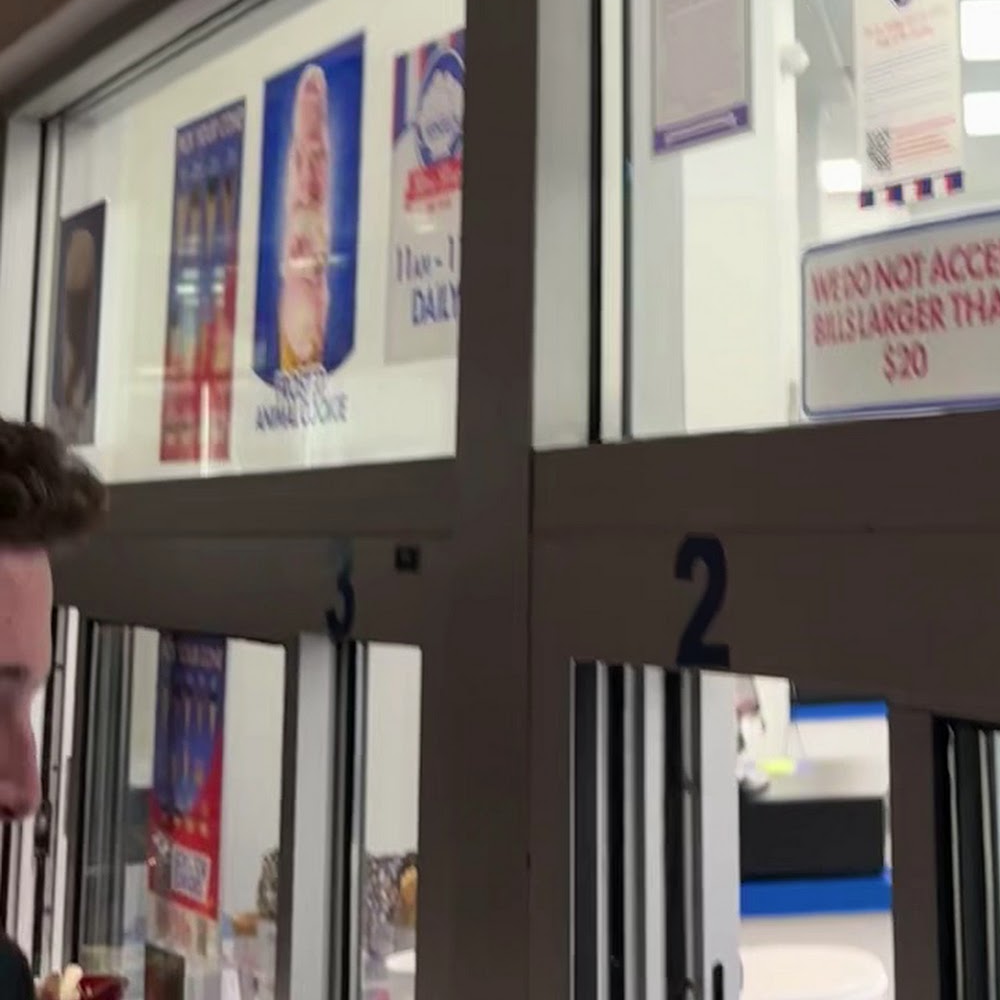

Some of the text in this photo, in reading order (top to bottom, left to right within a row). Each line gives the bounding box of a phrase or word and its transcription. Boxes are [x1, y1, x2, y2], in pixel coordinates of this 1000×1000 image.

[811, 267, 840, 302] WE
[843, 259, 872, 299] DO
[873, 251, 925, 294] NOT
[812, 310, 856, 346] BILLS
[858, 293, 946, 340] LARGER
[883, 340, 928, 384] $20
[674, 533, 731, 667] 2
